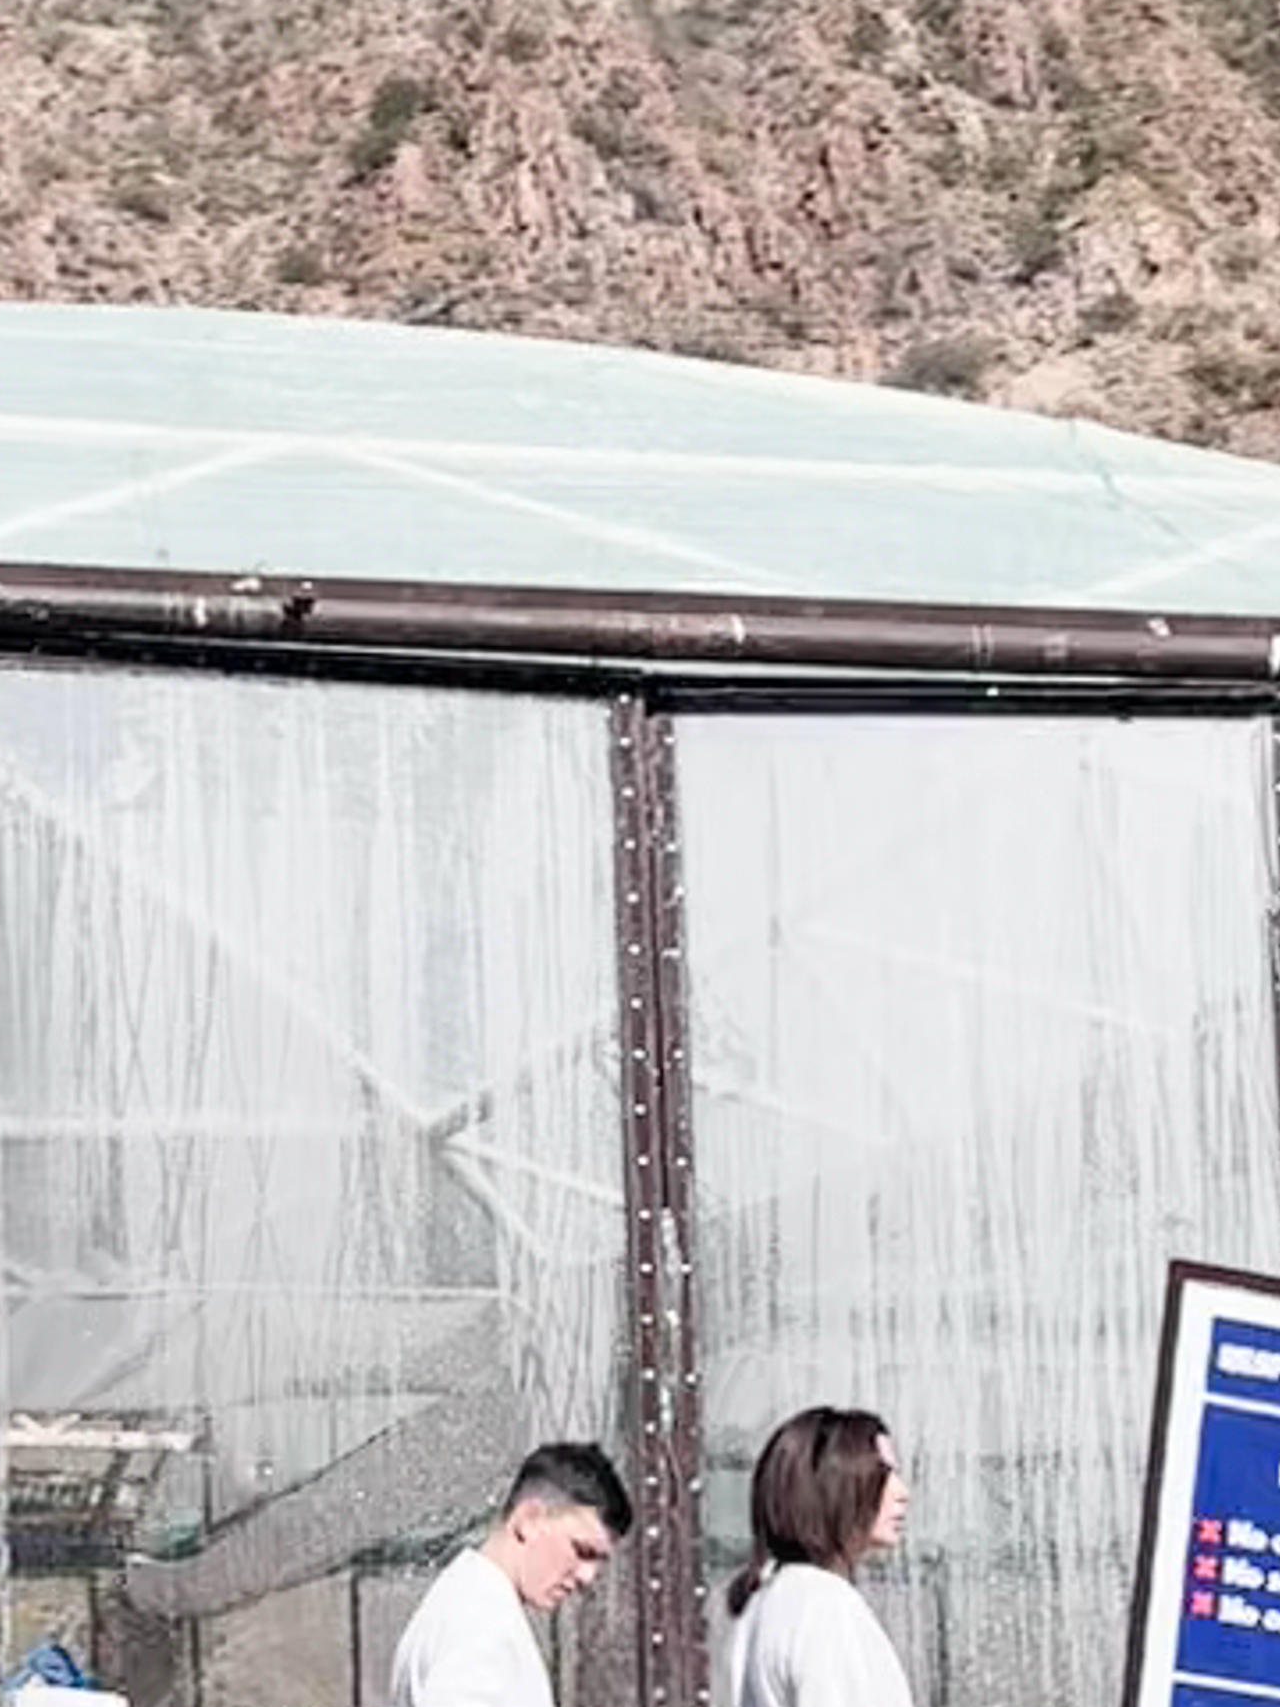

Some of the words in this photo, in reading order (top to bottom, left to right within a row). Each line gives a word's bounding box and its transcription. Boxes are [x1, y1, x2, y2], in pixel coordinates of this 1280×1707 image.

[1227, 1520, 1268, 1551] No
[1222, 1557, 1265, 1589] No
[1218, 1594, 1260, 1627] No
